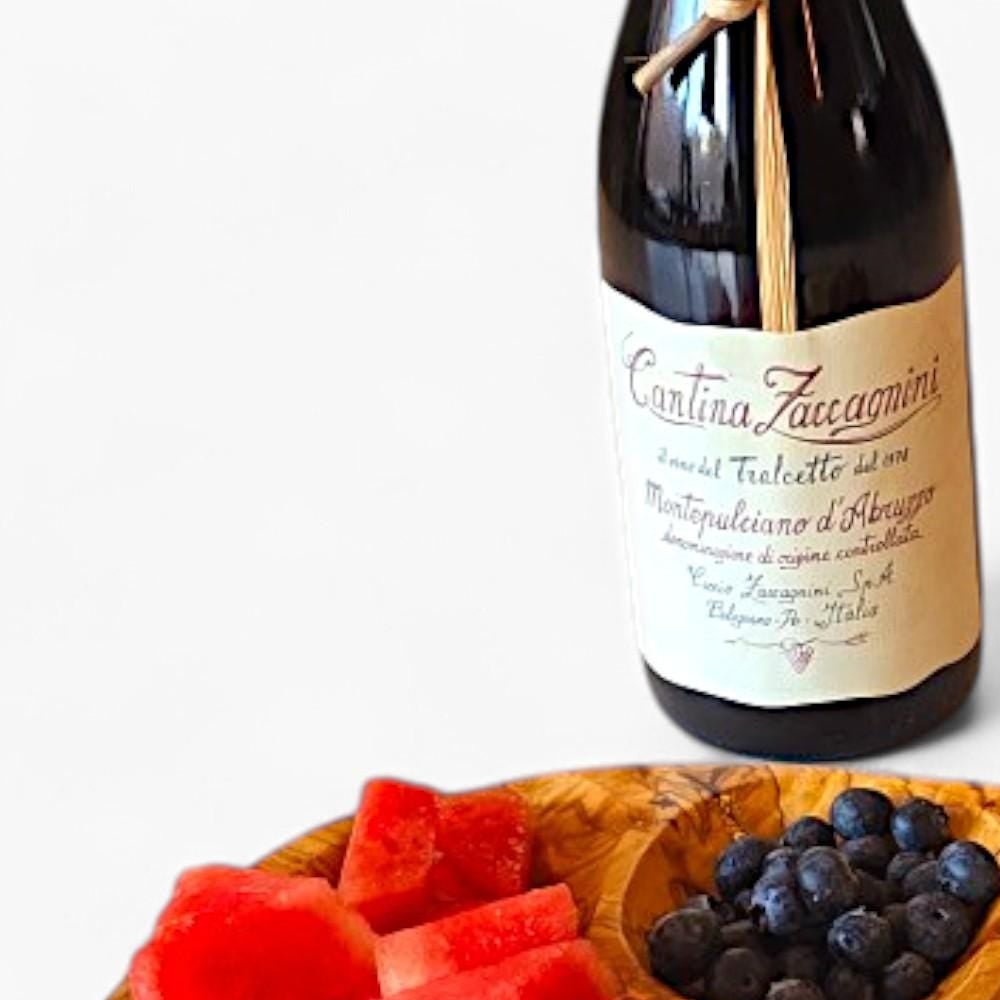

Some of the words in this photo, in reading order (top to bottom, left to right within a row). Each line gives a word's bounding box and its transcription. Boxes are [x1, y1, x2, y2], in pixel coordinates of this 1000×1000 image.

[622, 338, 752, 428] Cantina
[728, 451, 847, 486] Tralcetto
[646, 479, 811, 538] Montepulciano
[816, 484, 936, 533] d'Abruzzo
[757, 544, 774, 565] di
[777, 546, 831, 569] origine
[835, 523, 925, 561] controllata
